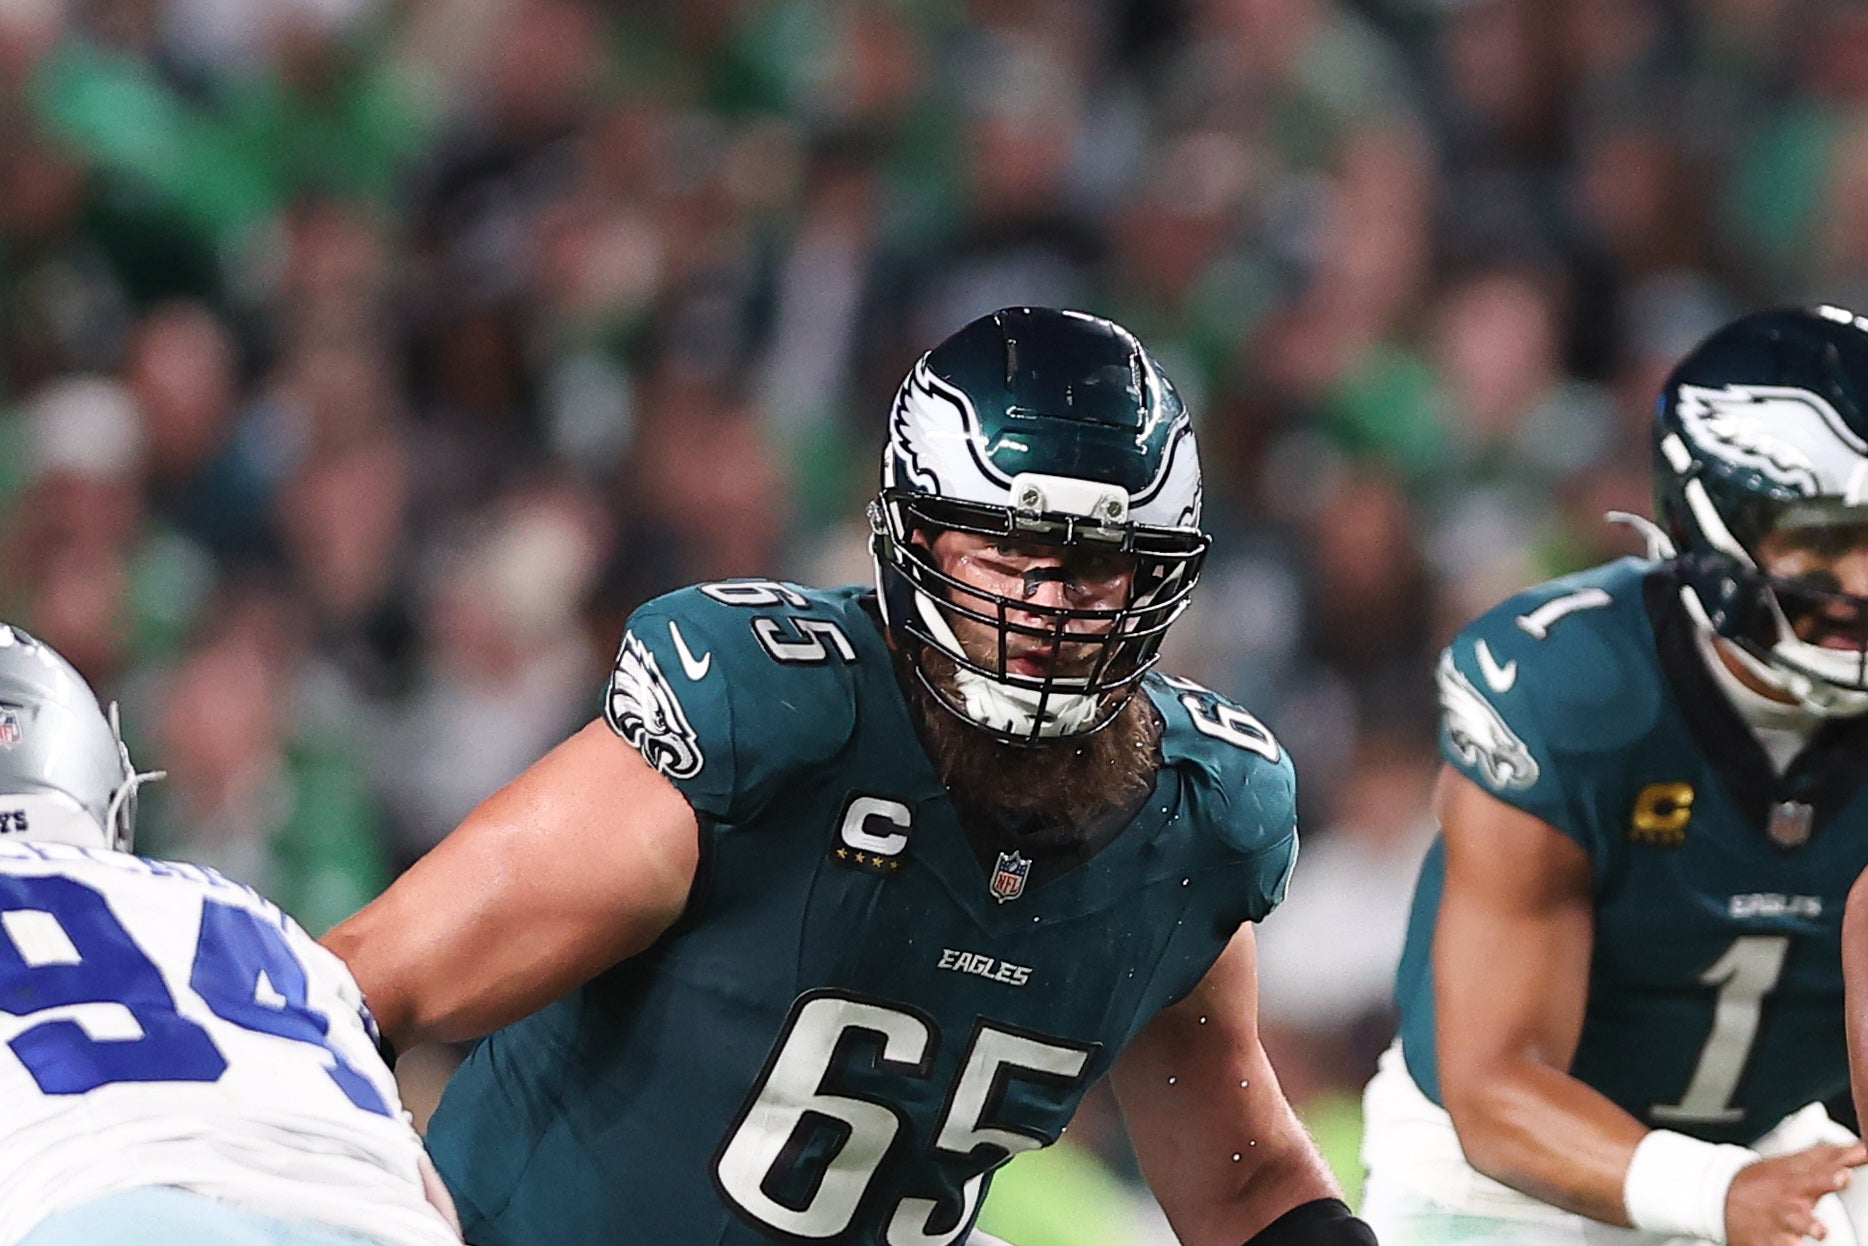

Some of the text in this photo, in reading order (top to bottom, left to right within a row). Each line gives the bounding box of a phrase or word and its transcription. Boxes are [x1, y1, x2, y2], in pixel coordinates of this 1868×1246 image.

[701, 581, 858, 663] 65
[1515, 587, 1614, 640] 1
[842, 796, 911, 856] C
[1632, 782, 1695, 830] C
[996, 874, 1019, 894] NFL
[0, 870, 394, 1118] 94
[937, 948, 1033, 987] EAGLES
[1650, 934, 1790, 1123] 1
